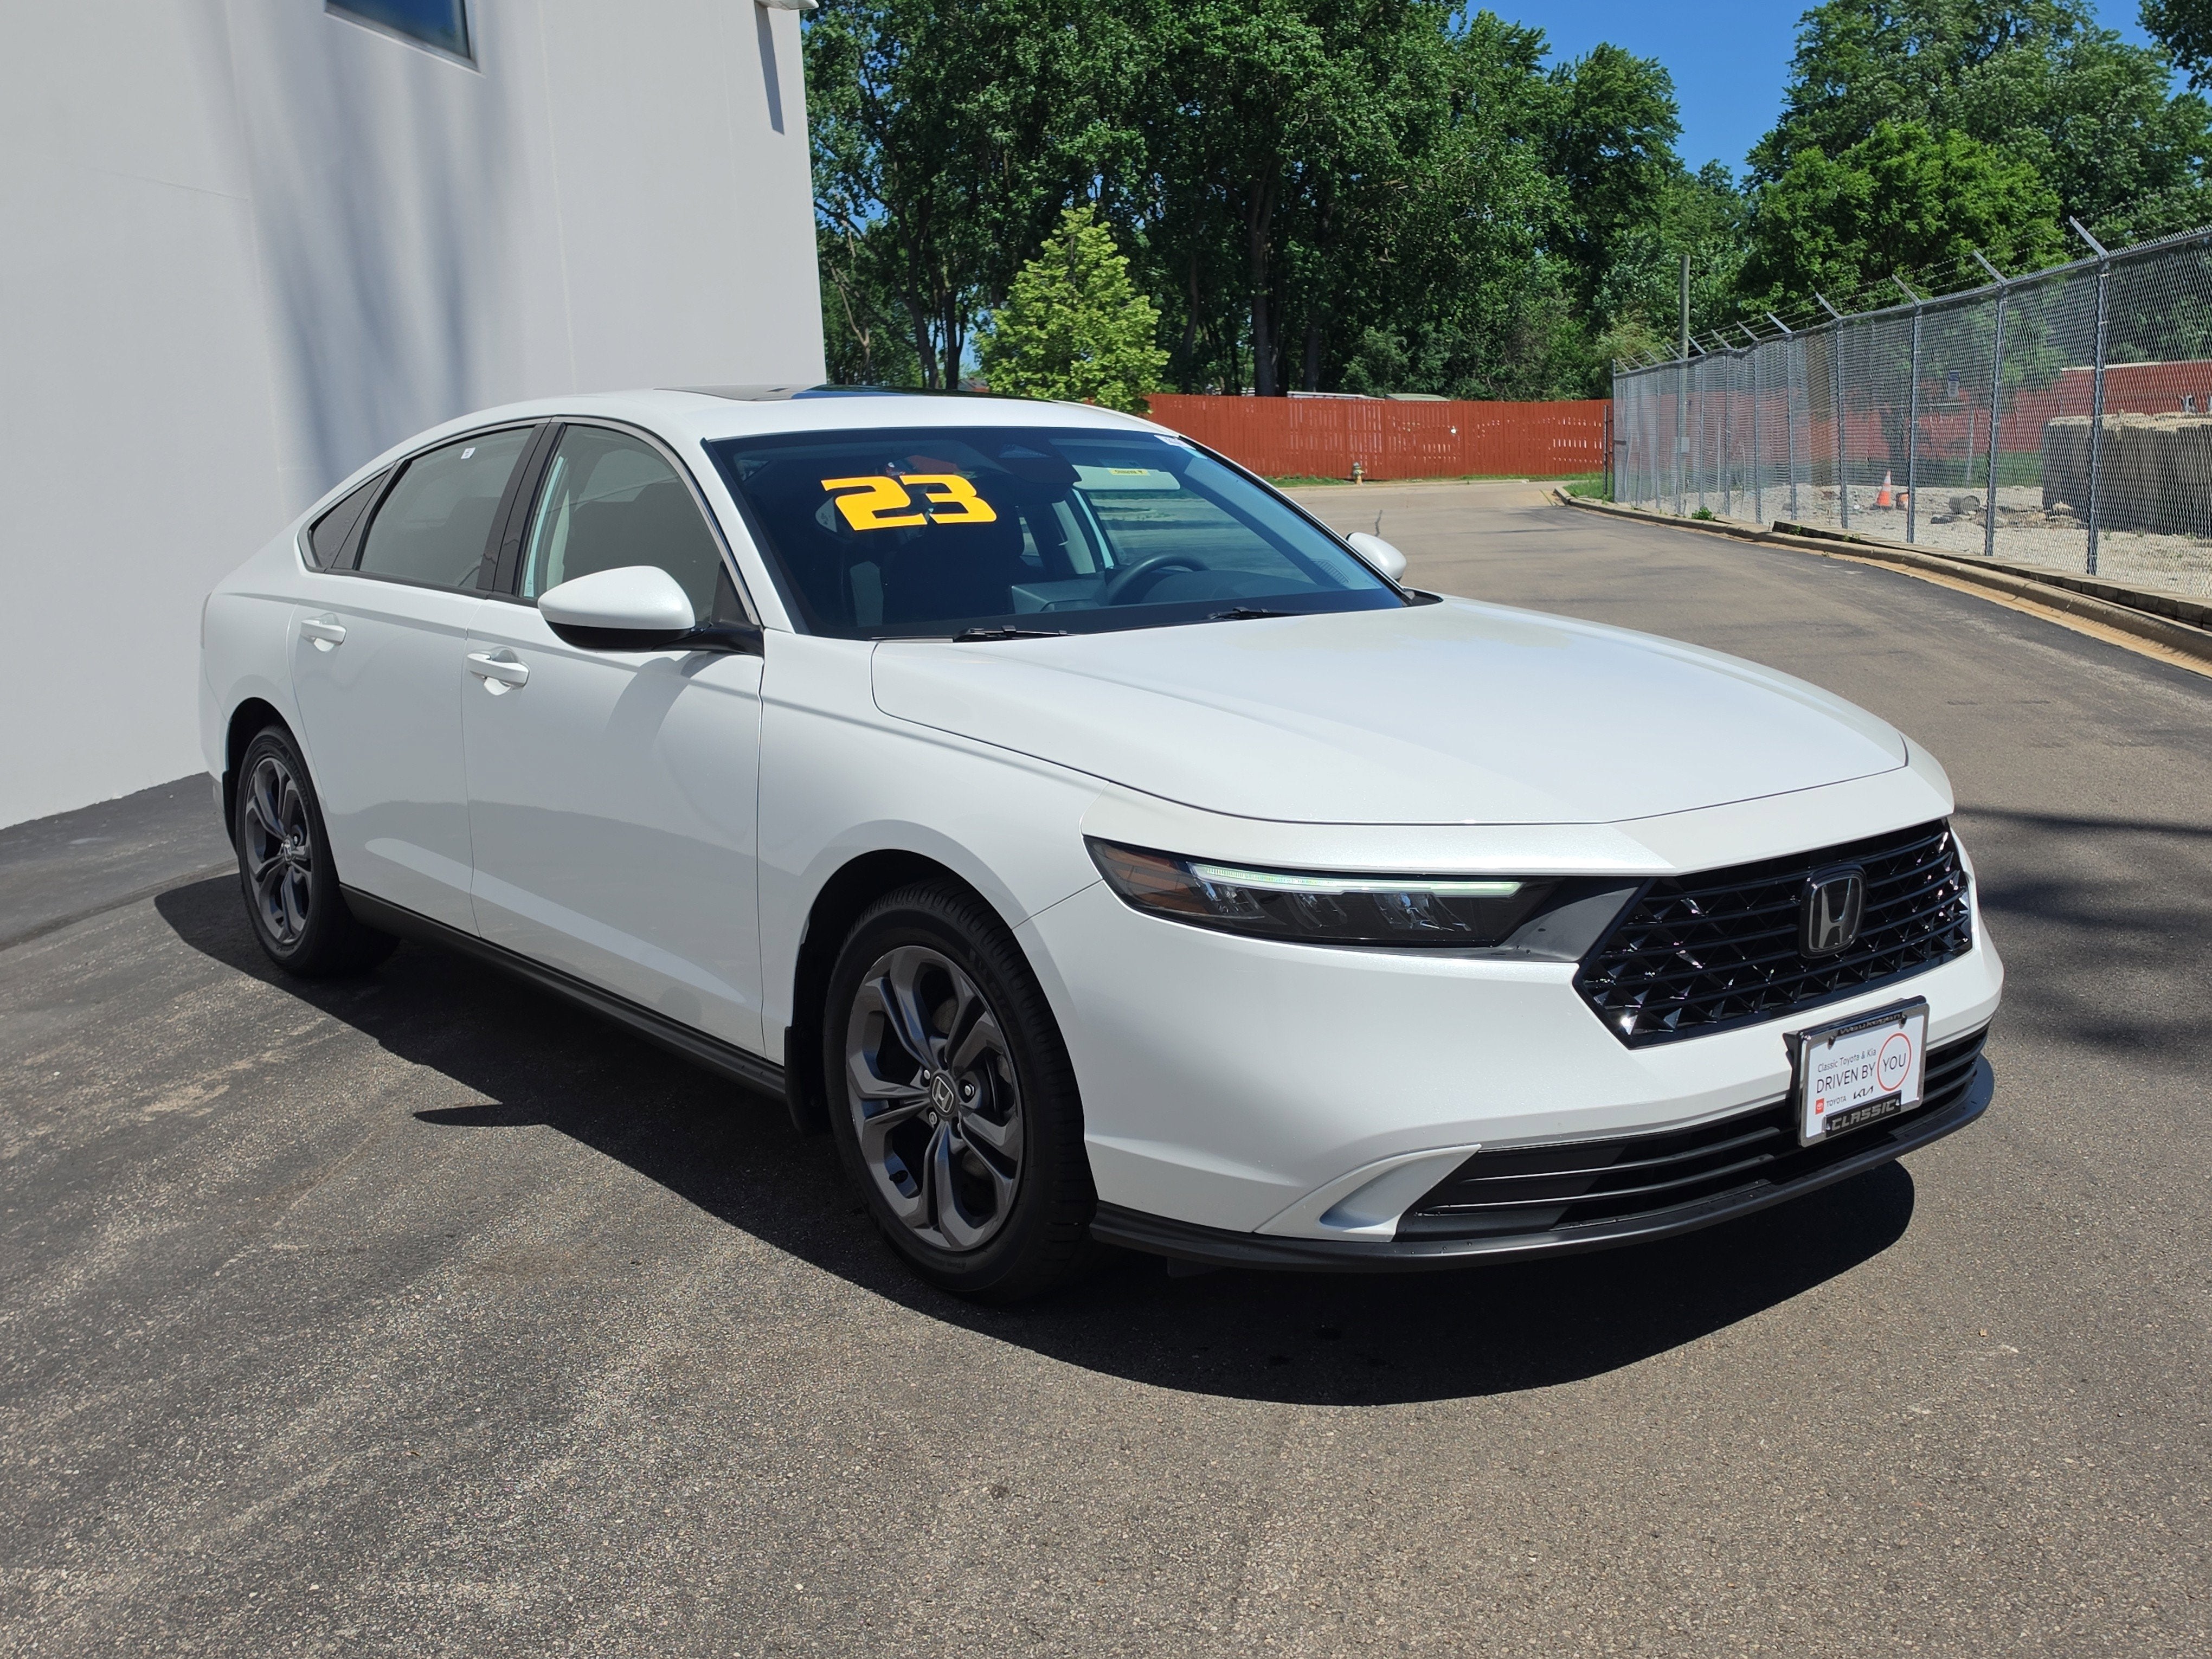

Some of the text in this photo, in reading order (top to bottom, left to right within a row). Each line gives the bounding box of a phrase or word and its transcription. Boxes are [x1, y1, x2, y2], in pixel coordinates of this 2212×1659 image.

[821, 474, 996, 531] 23
[1817, 1048, 1876, 1073] Classic Toyota & Kia
[1817, 1053, 1906, 1094] DRIVEN BY YOU
[1826, 1096, 1847, 1108] TOYOTA
[1831, 1098, 1897, 1131] CLASSIC
